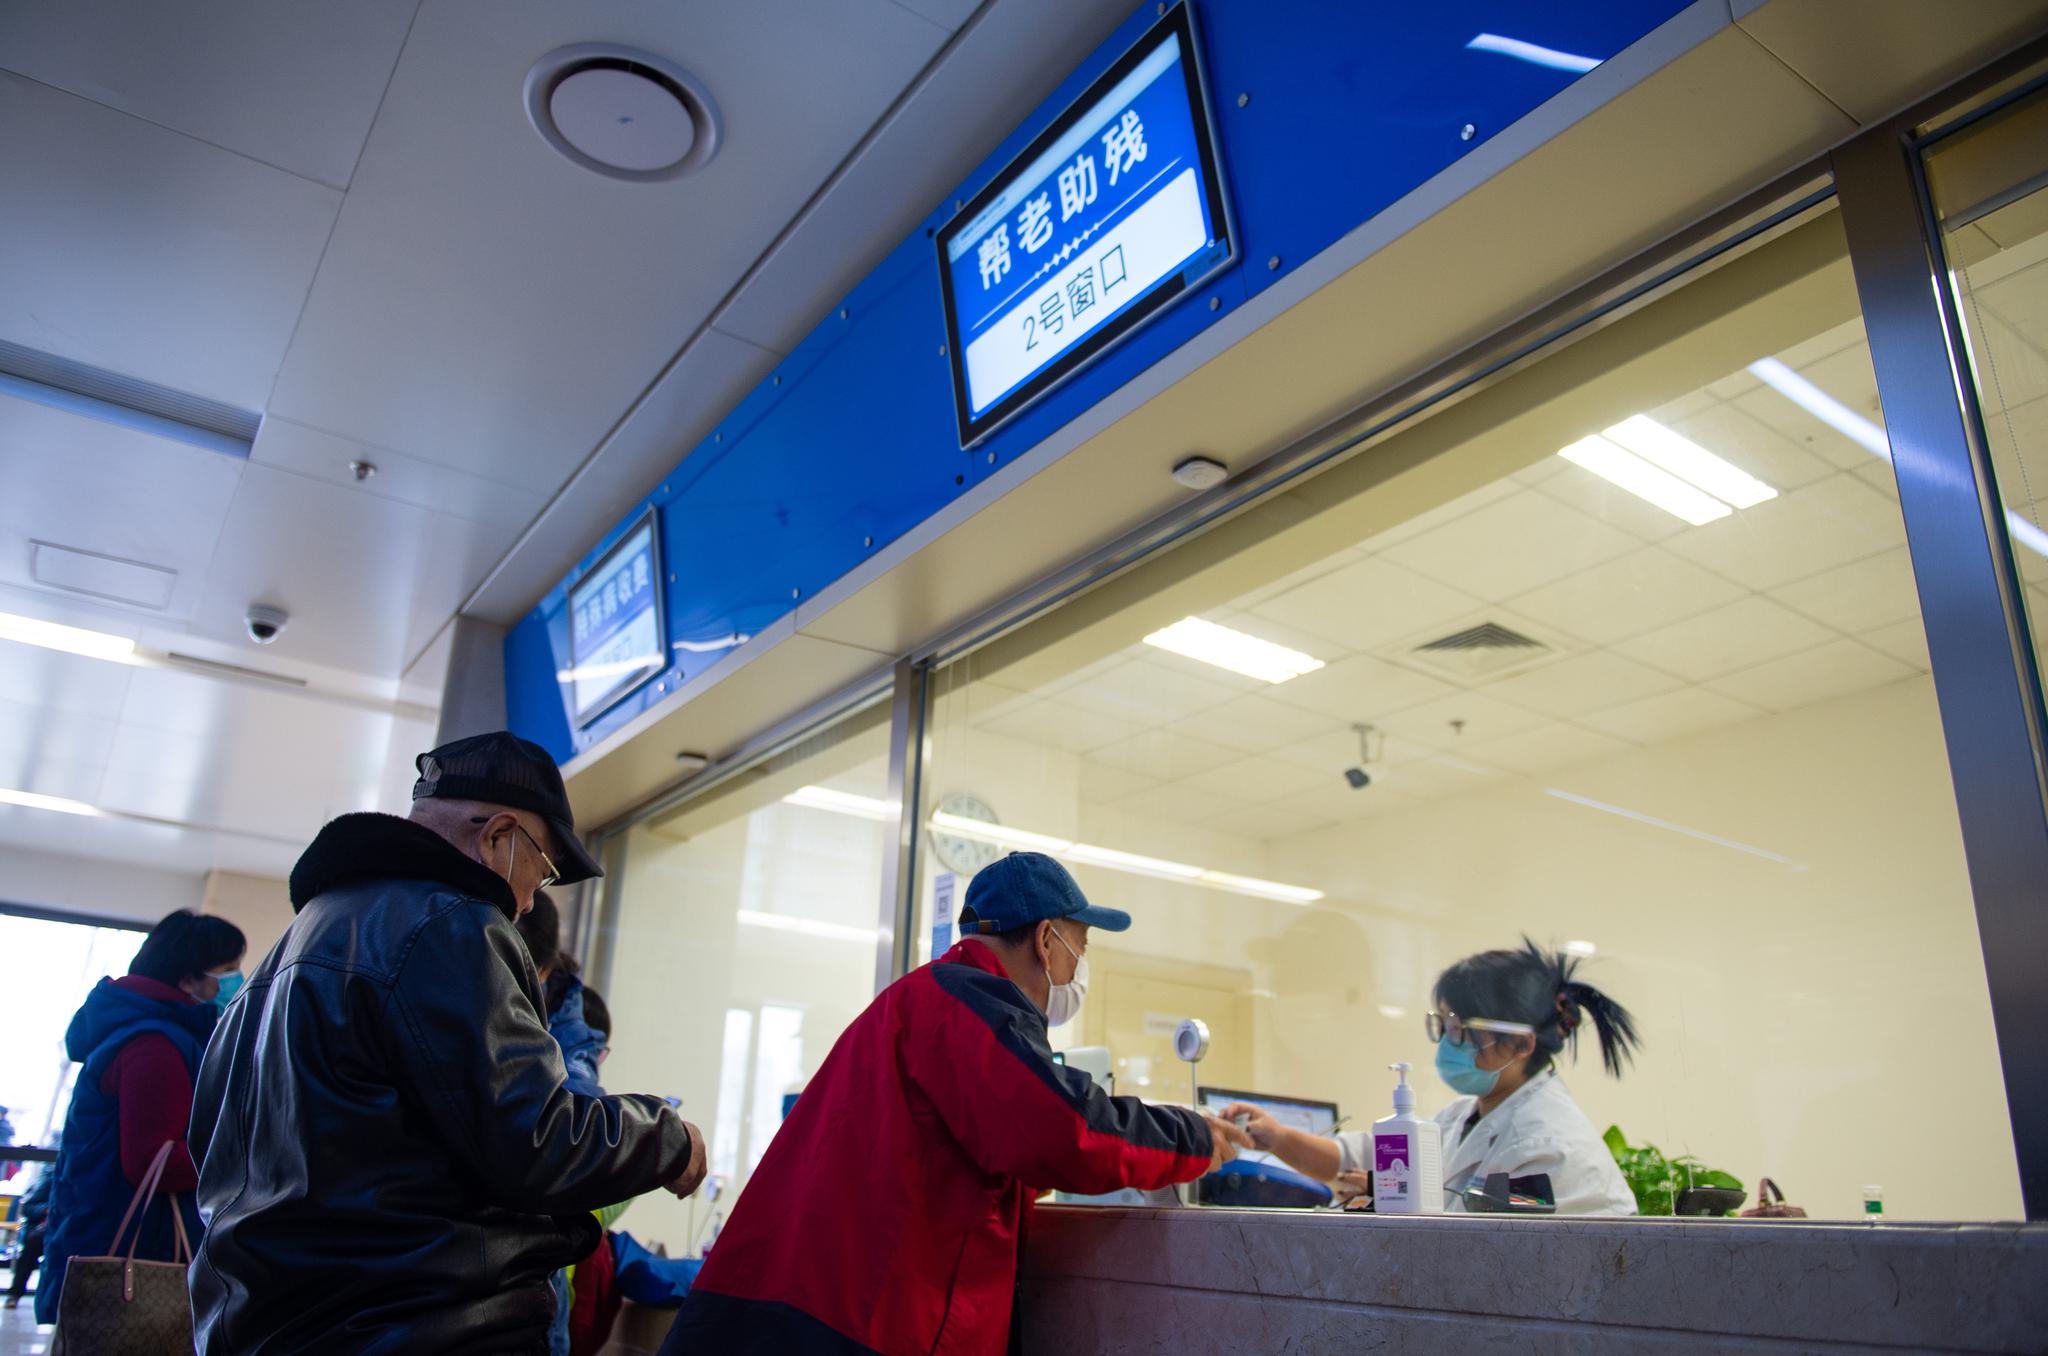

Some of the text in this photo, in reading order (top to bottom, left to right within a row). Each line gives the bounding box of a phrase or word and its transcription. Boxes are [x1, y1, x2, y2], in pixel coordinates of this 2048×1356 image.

[979, 109, 1148, 290] 帮老助残
[1023, 244, 1127, 351] 2号窗口
